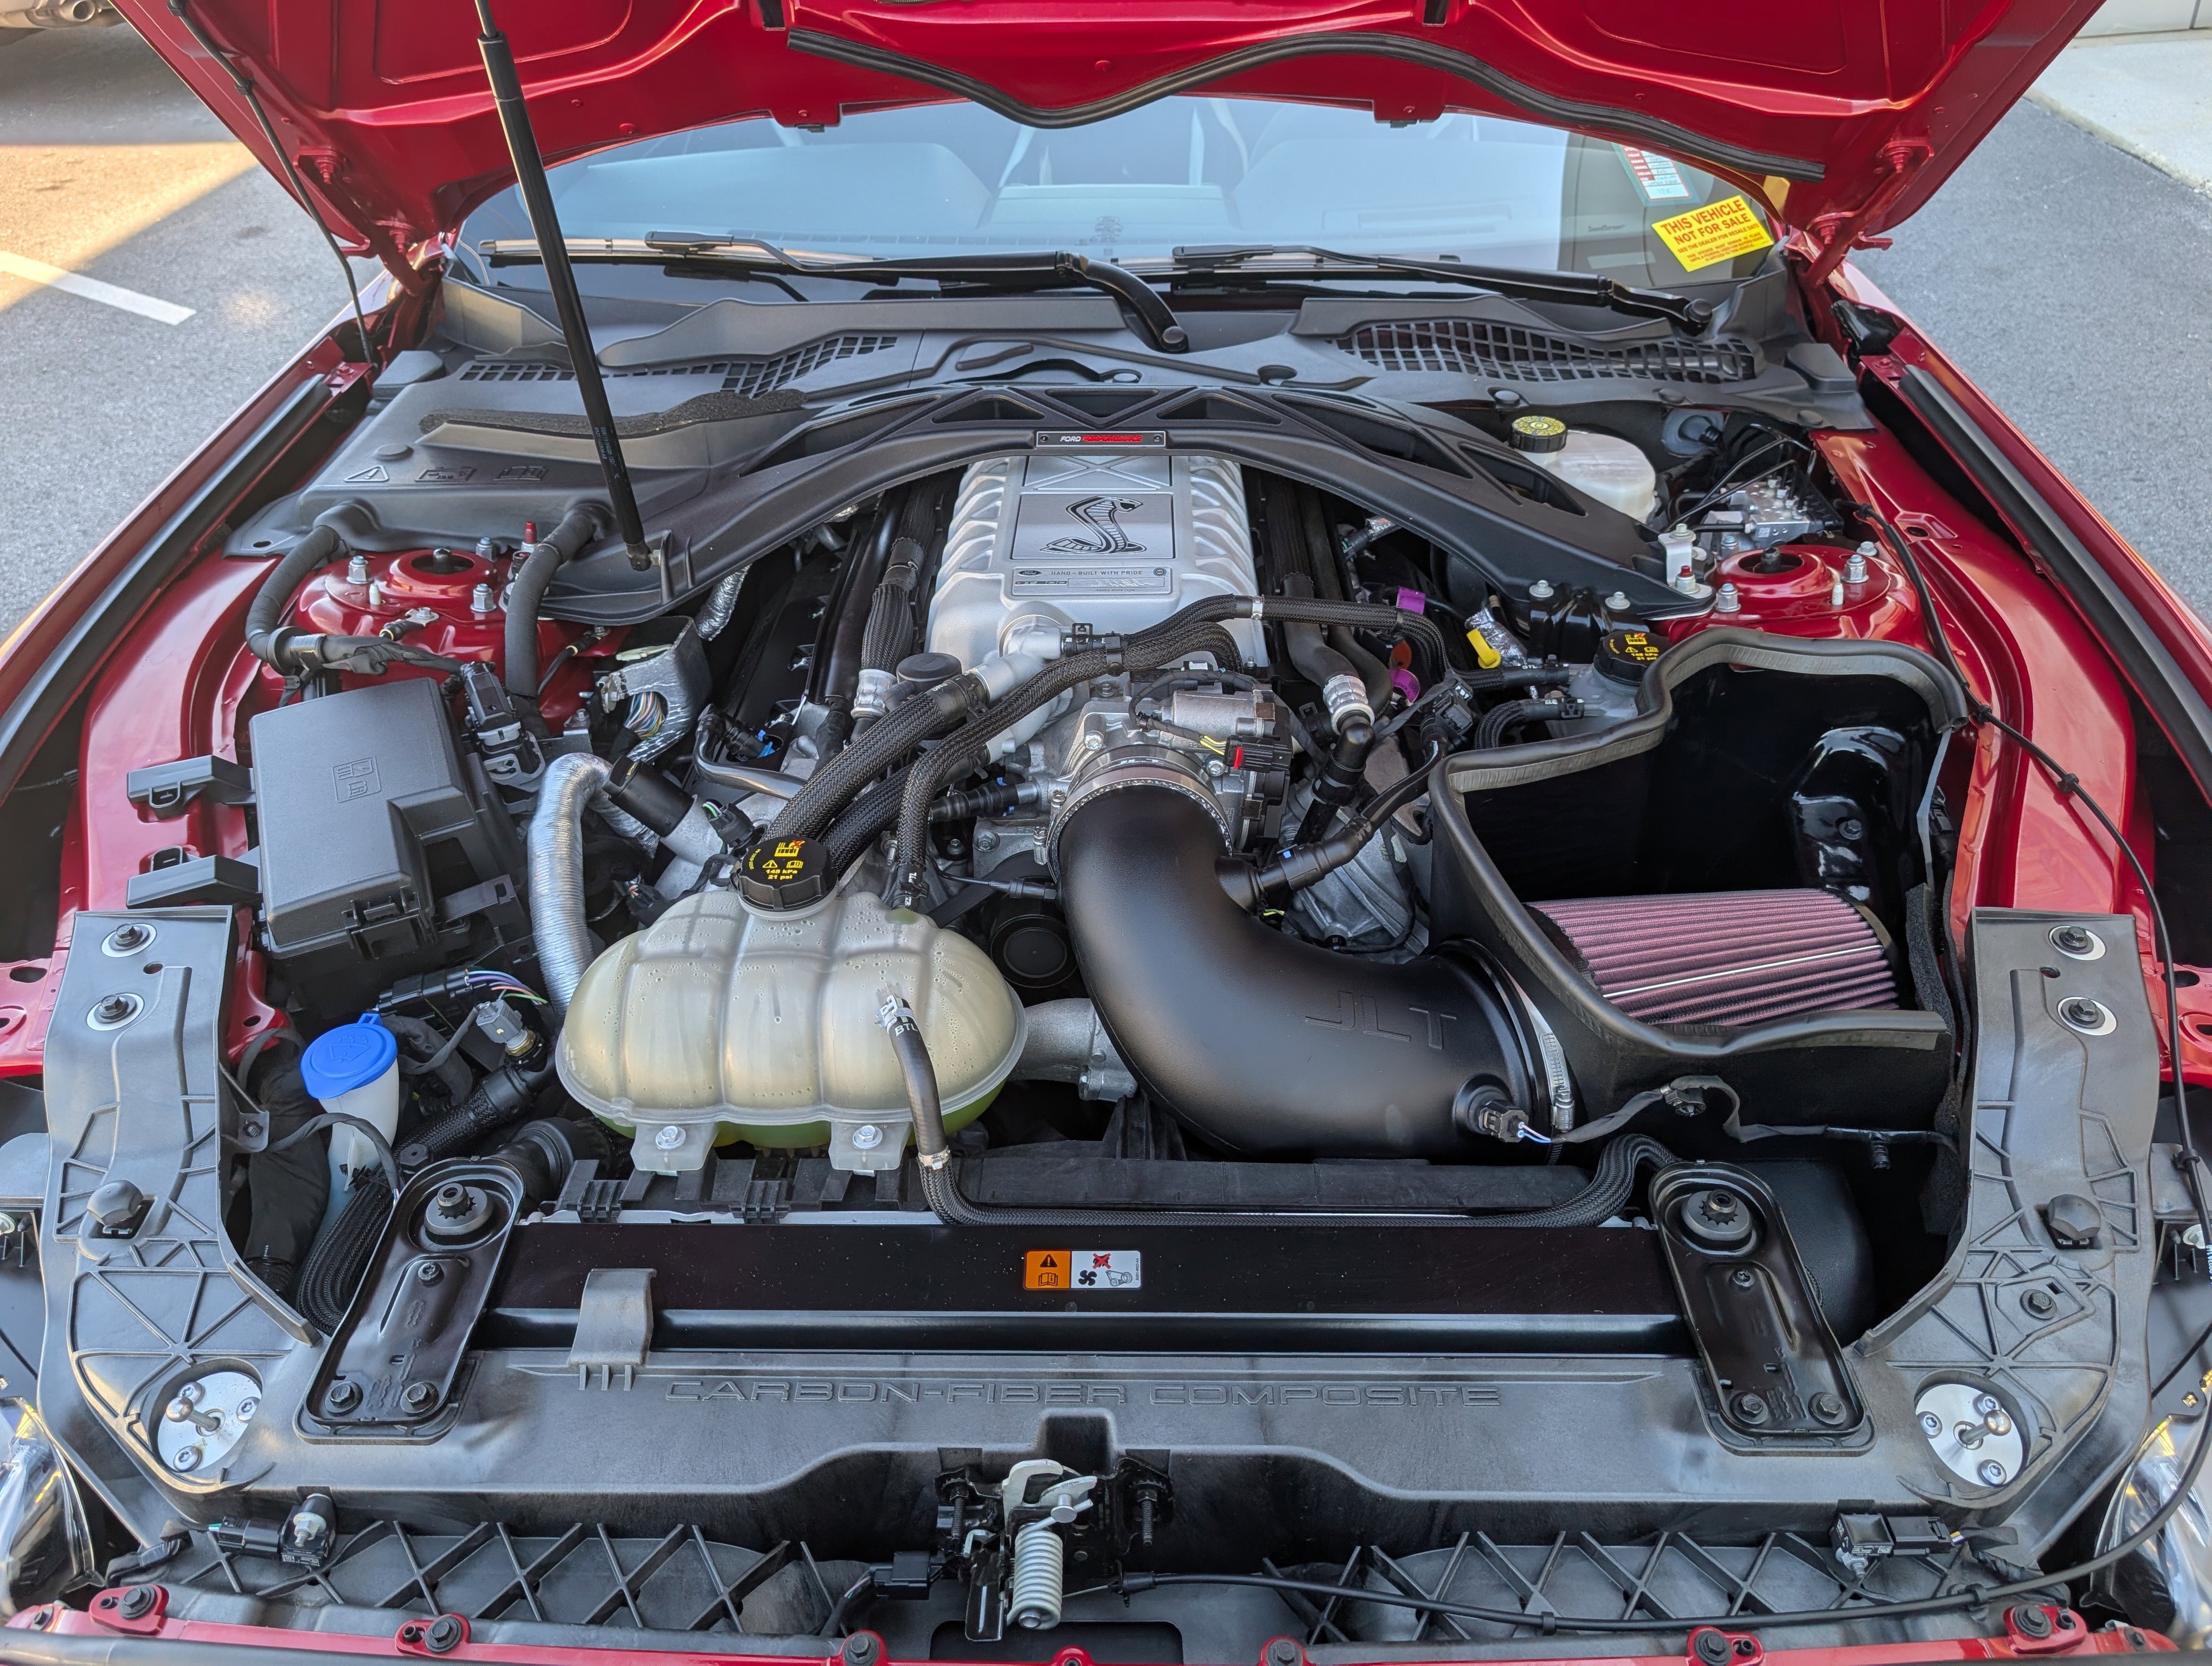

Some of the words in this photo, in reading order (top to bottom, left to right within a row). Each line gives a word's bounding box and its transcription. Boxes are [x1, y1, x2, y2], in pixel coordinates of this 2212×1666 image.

[1660, 217, 1693, 235] THIS
[1690, 199, 1746, 225] VEHICLE
[1673, 230, 1697, 245] NOT
[1697, 223, 1722, 237] FOR
[1722, 213, 1751, 229] SALE
[1697, 236, 1718, 247] DEALER
[1727, 226, 1748, 236] RESALE
[895, 1023, 918, 1037] BTL
[1305, 990, 1457, 1050] JLT
[665, 1380, 1127, 1405] CARBON-FIBER
[1149, 1384, 1501, 1407] COMPOSITE
